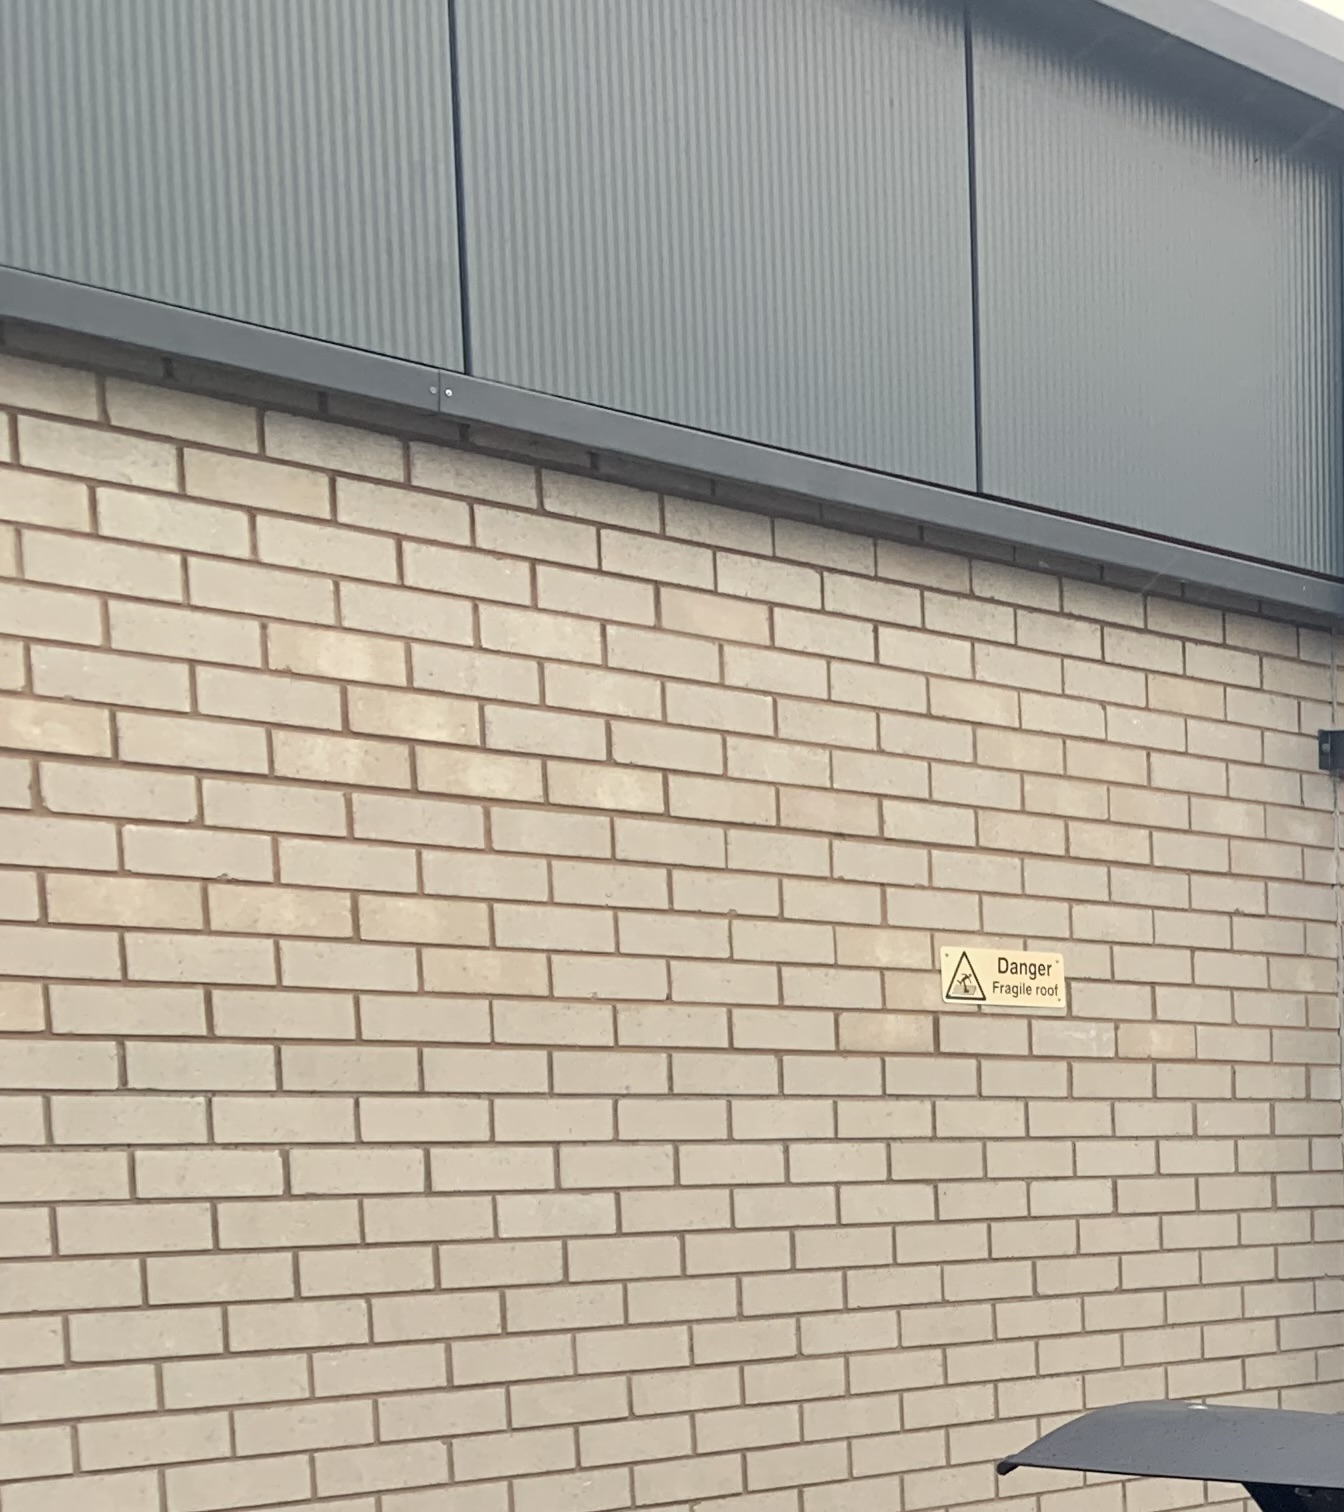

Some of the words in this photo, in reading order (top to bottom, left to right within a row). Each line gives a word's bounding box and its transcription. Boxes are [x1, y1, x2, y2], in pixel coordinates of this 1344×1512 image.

[997, 957, 1053, 980] Danger
[992, 981, 1033, 998] Fragile
[1035, 984, 1059, 997] roof
